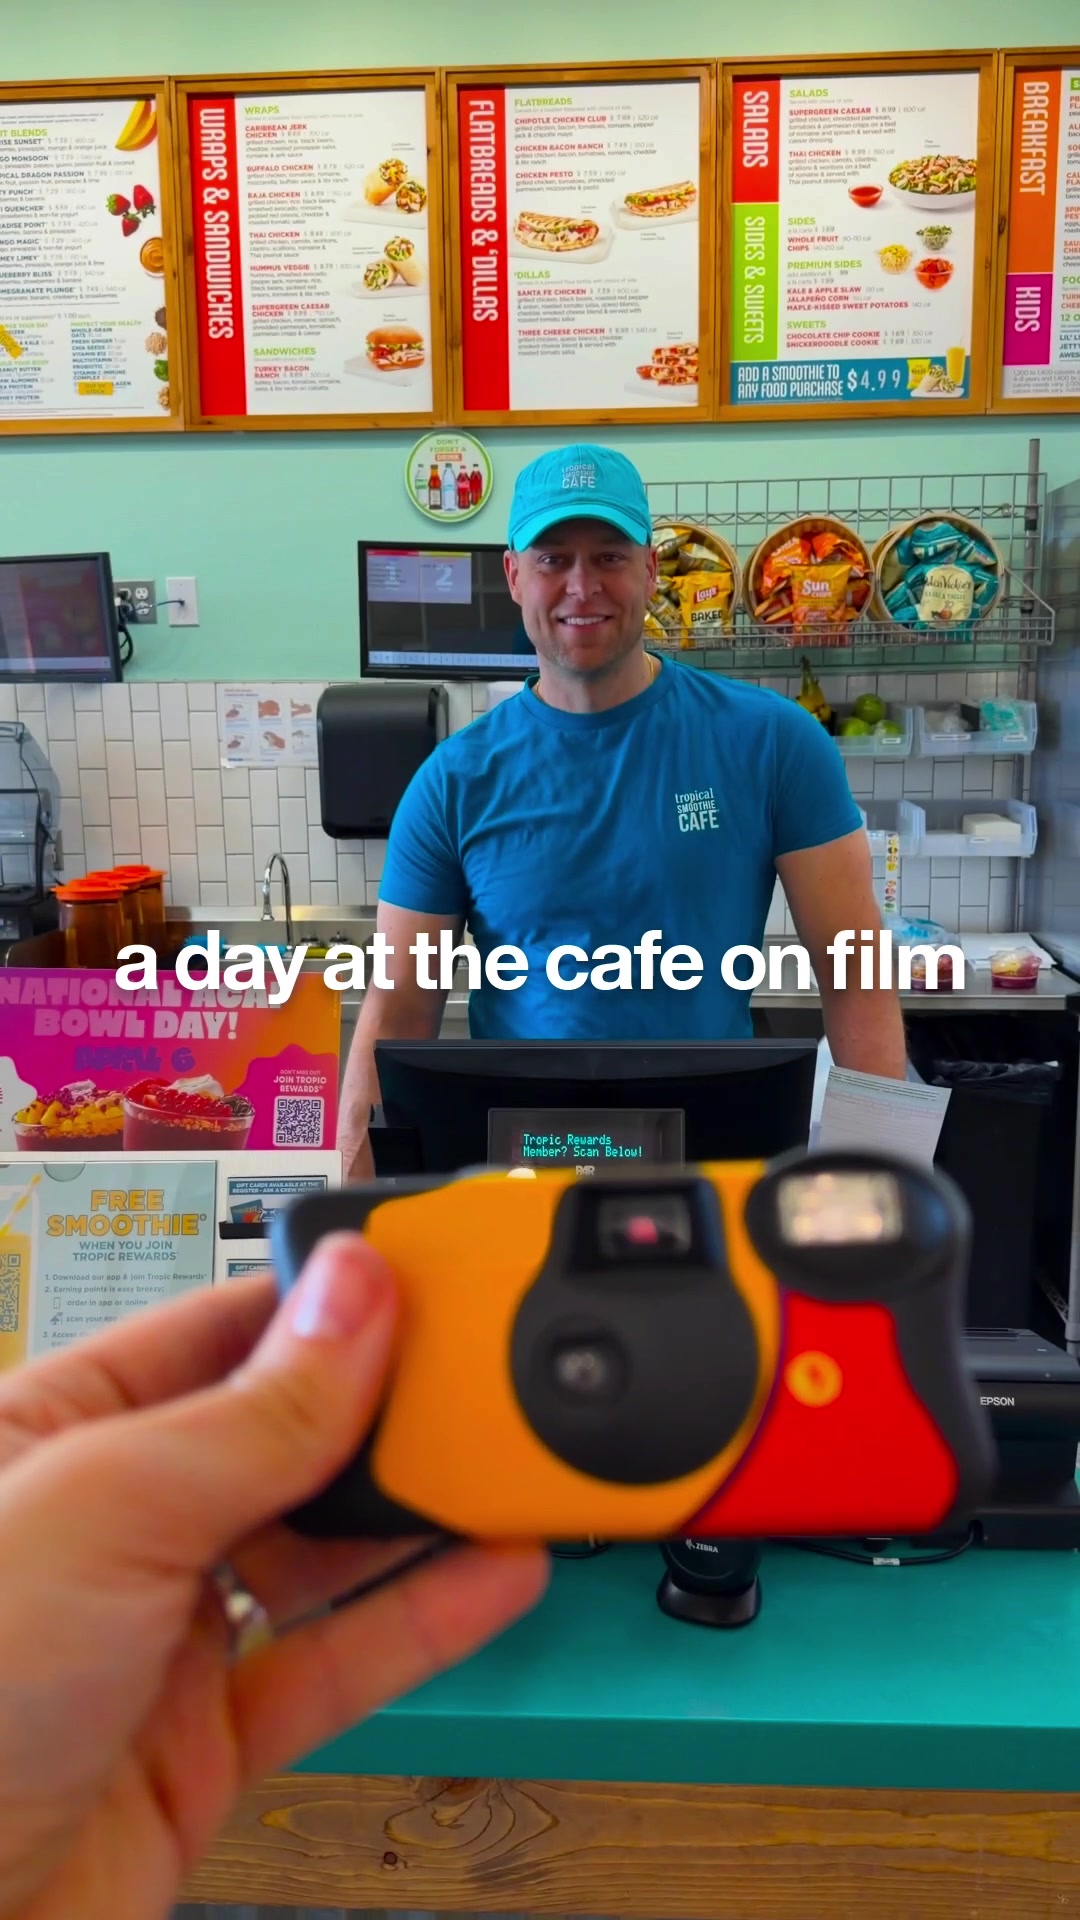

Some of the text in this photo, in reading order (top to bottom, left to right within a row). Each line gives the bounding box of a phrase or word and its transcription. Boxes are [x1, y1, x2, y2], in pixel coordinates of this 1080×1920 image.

[789, 89, 829, 98] SALADS
[514, 98, 572, 107] FLATBREADS
[244, 106, 279, 114] WRAPS
[789, 108, 838, 116] SUPERGREEN
[514, 116, 550, 124] CHIPOTLE
[11, 129, 47, 137] BLENDS
[742, 91, 769, 168] SALADS
[1020, 81, 1049, 196] BREAKFAST
[469, 100, 496, 222] FLATBREADS
[200, 108, 234, 340] WRAPS & SANDWICHES
[472, 229, 498, 246] &
[787, 260, 862, 269] PREMIUM SIDES
[744, 216, 765, 344] SIDES & SWEETS
[787, 303, 840, 311] MAPLE-KISSED
[1014, 287, 1041, 332] KIDS
[787, 320, 826, 329] SWEETS
[787, 331, 831, 340] CHOCOLATE
[253, 347, 316, 356] SANDWICHES
[738, 364, 840, 382] ADD A SMOOTHIE TO
[738, 380, 843, 399] ANY FOOD PURCHASE
[562, 476, 596, 489] CAFE
[436, 565, 453, 586] 2
[802, 579, 830, 597] Sun
[675, 788, 714, 804] tropical
[677, 800, 716, 814] SMOOTHIE
[678, 810, 719, 832] CAFE
[0, 977, 182, 1007] NATIONAL
[33, 1009, 239, 1040] BOWL DAY!
[171, 1047, 196, 1073] 6
[523, 1133, 612, 1146] Tropic Rewards
[523, 1146, 642, 1157] Member? Scan Below!
[90, 1190, 164, 1212] FREE
[79, 1240, 173, 1250] WHEN YOU JOIN
[72, 1252, 116, 1262] TROPIC
[130, 1274, 145, 1282] join
[147, 1274, 170, 1282] Tropic
[980, 1395, 1015, 1407] EPSON
[695, 1542, 718, 1554] ZEBRA
